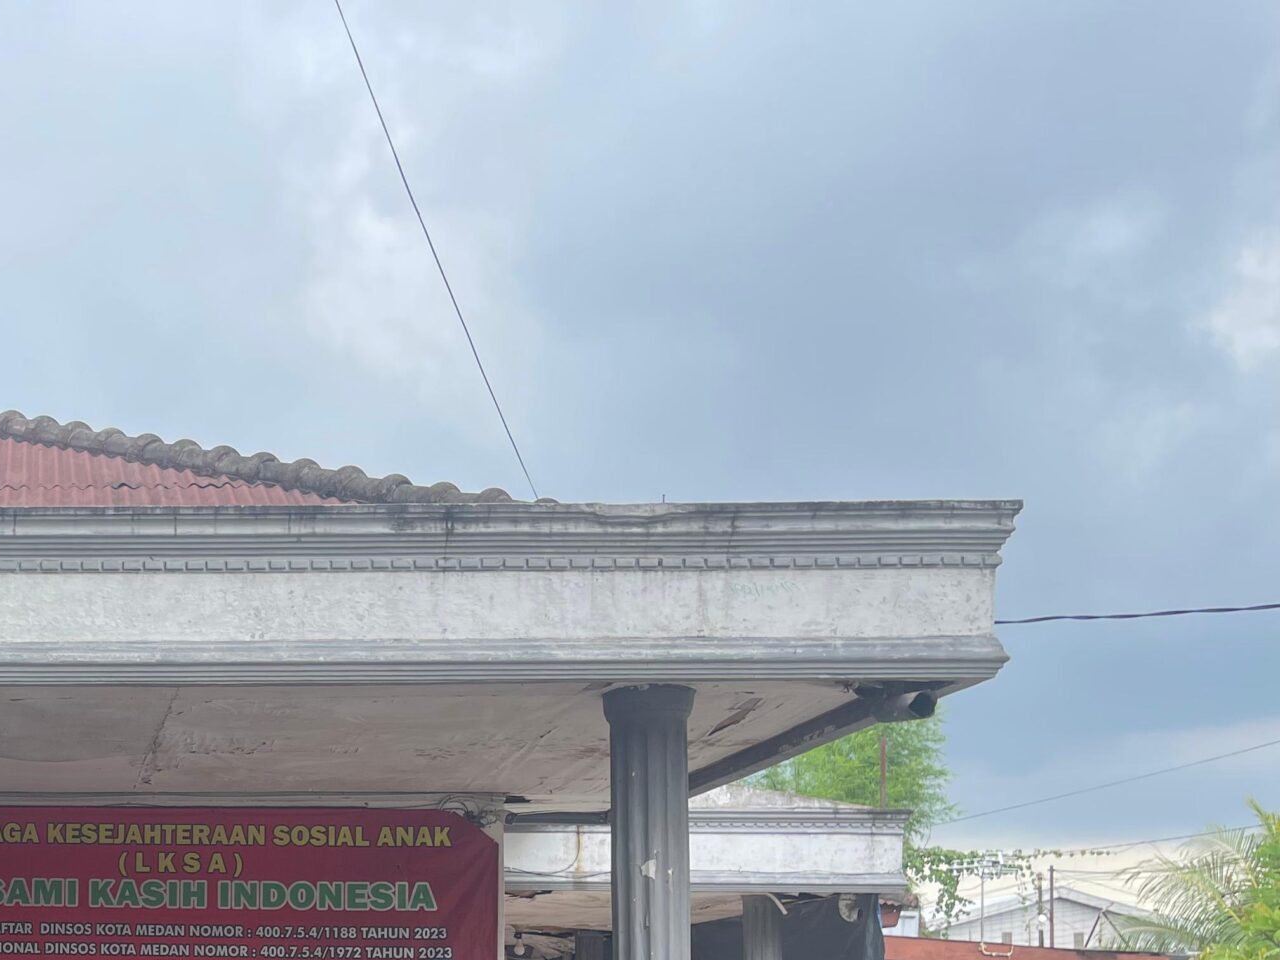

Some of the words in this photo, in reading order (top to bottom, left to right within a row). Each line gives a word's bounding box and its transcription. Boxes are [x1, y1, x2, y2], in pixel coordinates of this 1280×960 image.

[47, 823, 266, 846] KESEJAHTERAAN
[272, 825, 370, 847] SOSIAL
[376, 826, 452, 848] ANAK
[88, 878, 207, 909] KASIH
[218, 880, 437, 912] INDONESIA
[41, 923, 92, 935] DINSOS
[96, 924, 132, 936] KOTA
[135, 924, 185, 937] MEDAN
[189, 925, 244, 937] NOMOR
[256, 926, 357, 939] 400.7.5.4/1188
[361, 927, 411, 939] TAHUN
[414, 928, 448, 940] 2023
[44, 942, 96, 955] DINSOS
[100, 943, 136, 955] KOTA
[140, 944, 190, 957] MEDAN
[193, 945, 248, 958] NOMOR
[260, 946, 362, 959] 400.7.5.4/1972
[366, 947, 414, 959] TAHUN
[418, 947, 453, 960] 2023
